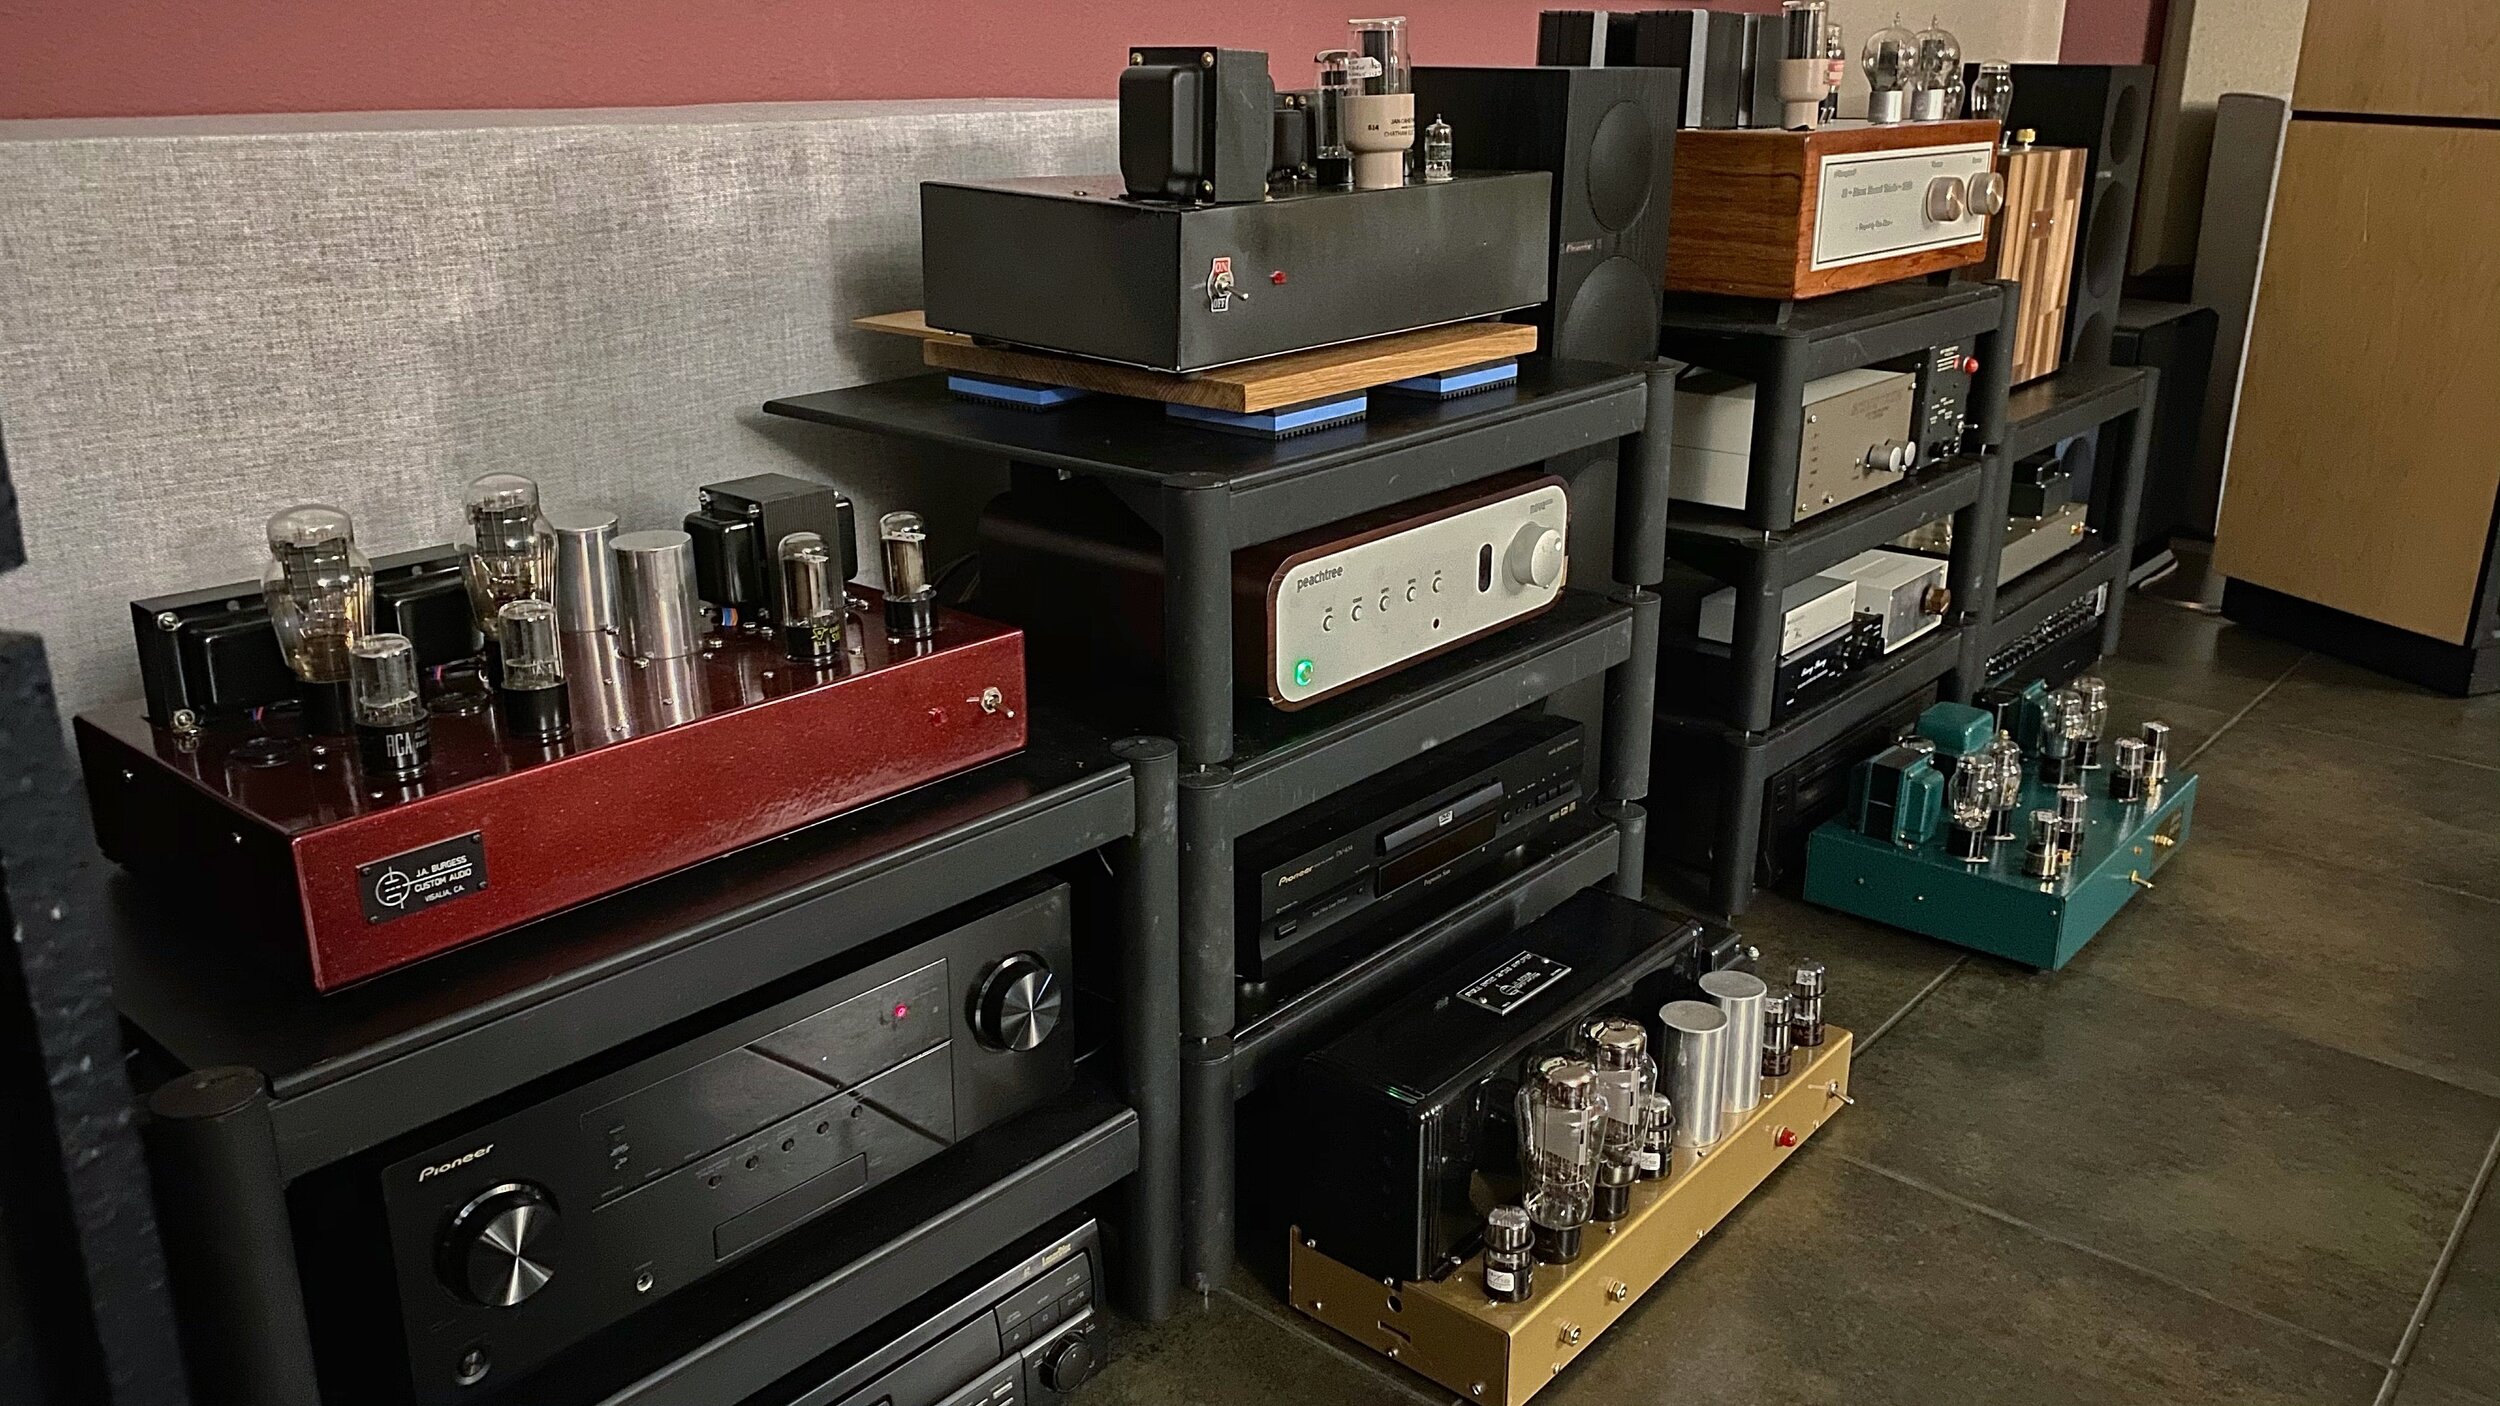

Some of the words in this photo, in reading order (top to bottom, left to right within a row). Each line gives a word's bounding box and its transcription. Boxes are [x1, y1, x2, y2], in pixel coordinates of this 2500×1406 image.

[1215, 261, 1229, 273] ON
[1213, 298, 1226, 309] OFF
[1296, 566, 1344, 594] peachtree
[385, 731, 413, 758] RCA
[431, 855, 468, 873] BURGESS
[1278, 865, 1314, 887] Pioneer
[414, 876, 447, 893] CUSTOM
[449, 867, 472, 882] AUDIO
[419, 1143, 495, 1183] Pioneer
